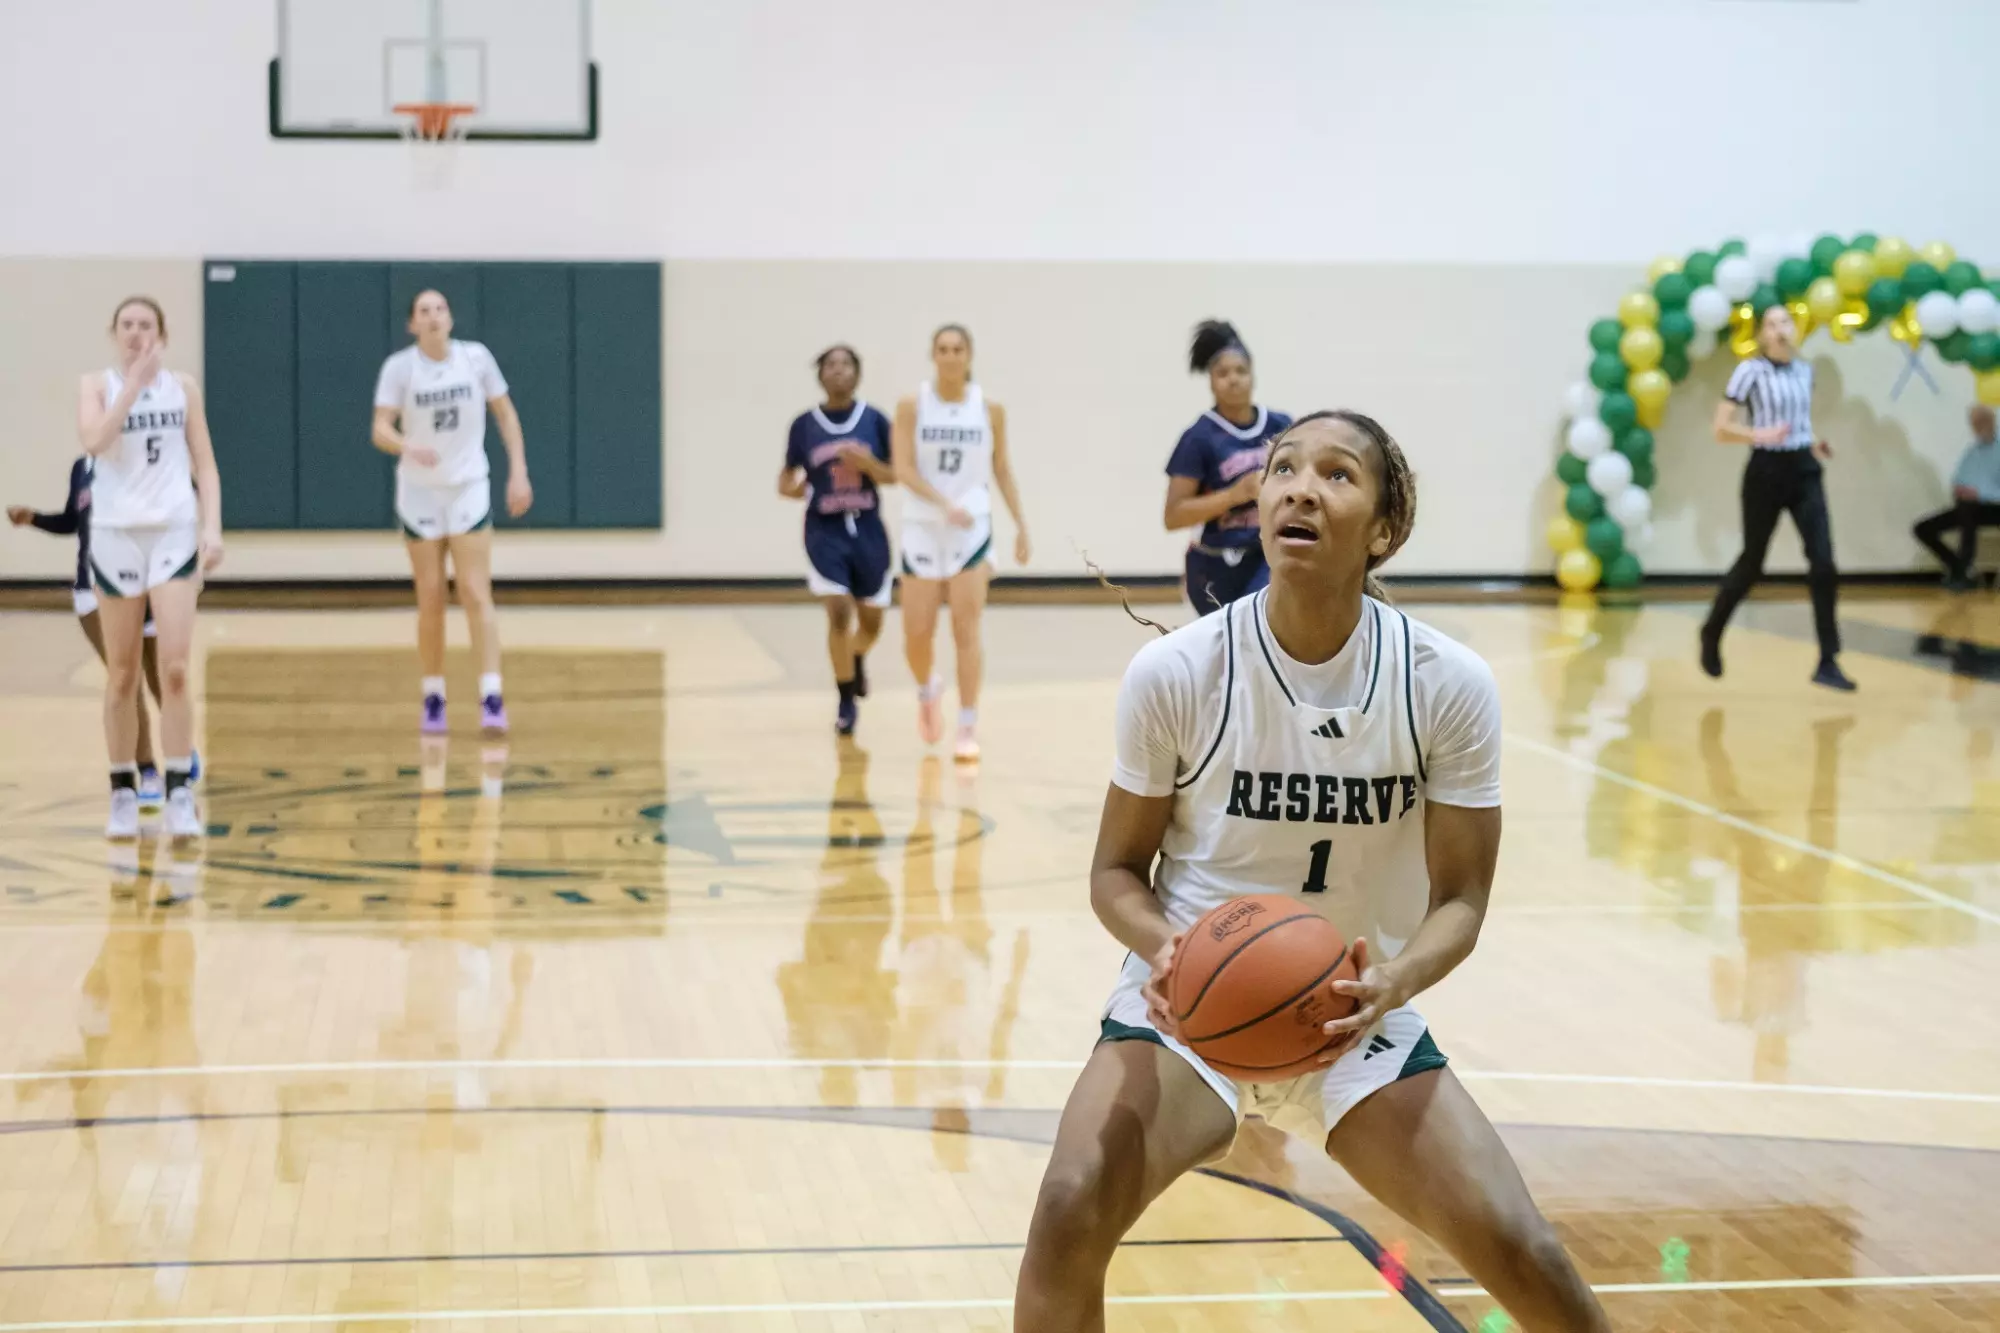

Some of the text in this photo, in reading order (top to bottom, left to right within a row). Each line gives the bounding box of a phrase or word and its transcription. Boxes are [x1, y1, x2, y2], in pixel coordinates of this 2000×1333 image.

[121, 409, 184, 432] ESERVE
[146, 435, 162, 465] 5
[938, 448, 962, 475] 13
[1226, 769, 1417, 825] RESERVE
[1302, 839, 1333, 893] 1
